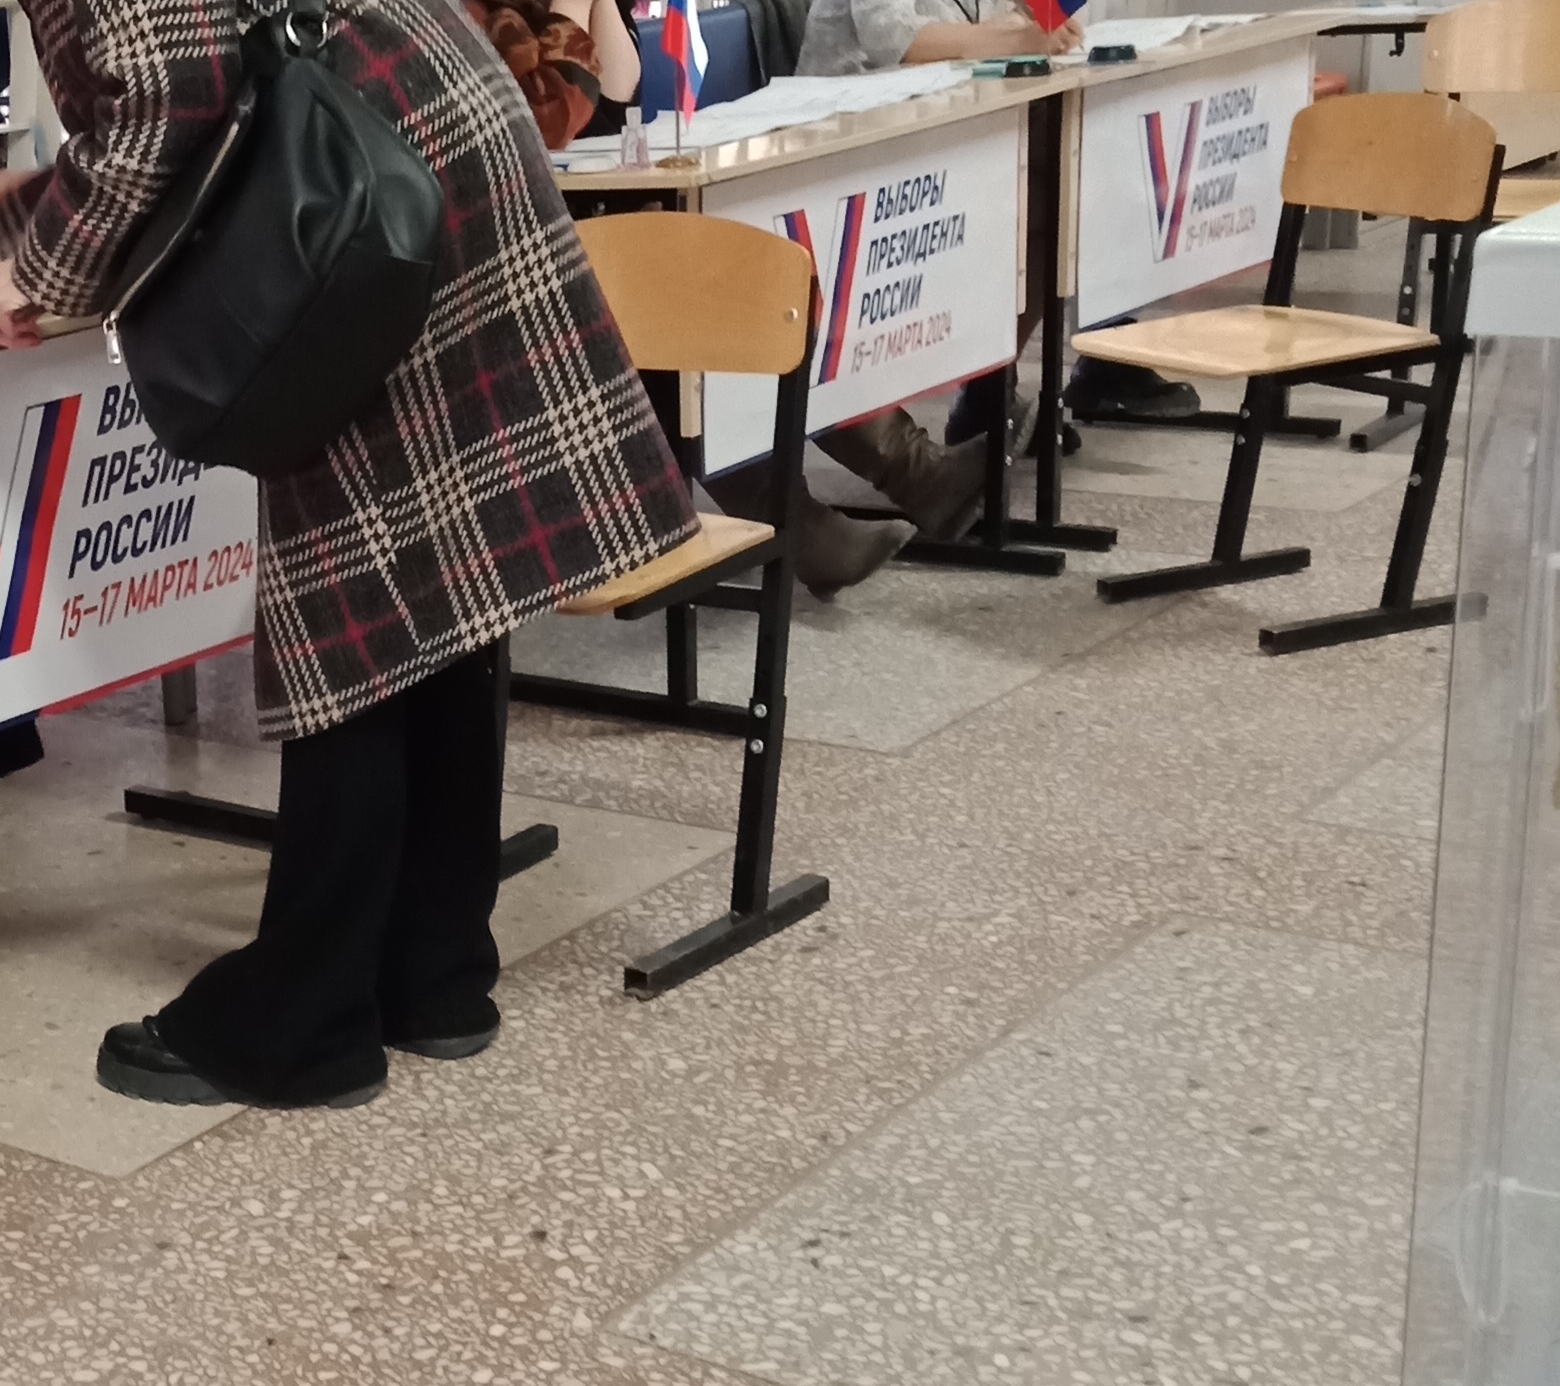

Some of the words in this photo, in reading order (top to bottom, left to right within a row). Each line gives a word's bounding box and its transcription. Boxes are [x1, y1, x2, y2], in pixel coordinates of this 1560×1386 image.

[873, 169, 947, 224] ВЫБОРЫ
[866, 211, 966, 277] ПРЕЗИДЕНТА
[858, 273, 924, 329] РОССИИ
[884, 316, 924, 362] МАРТА
[925, 309, 953, 349] 2024
[82, 439, 208, 508] ПРЕЗИД
[68, 495, 196, 580] РОССИИ
[124, 556, 199, 618] МАРТА
[203, 538, 254, 592] 2024
